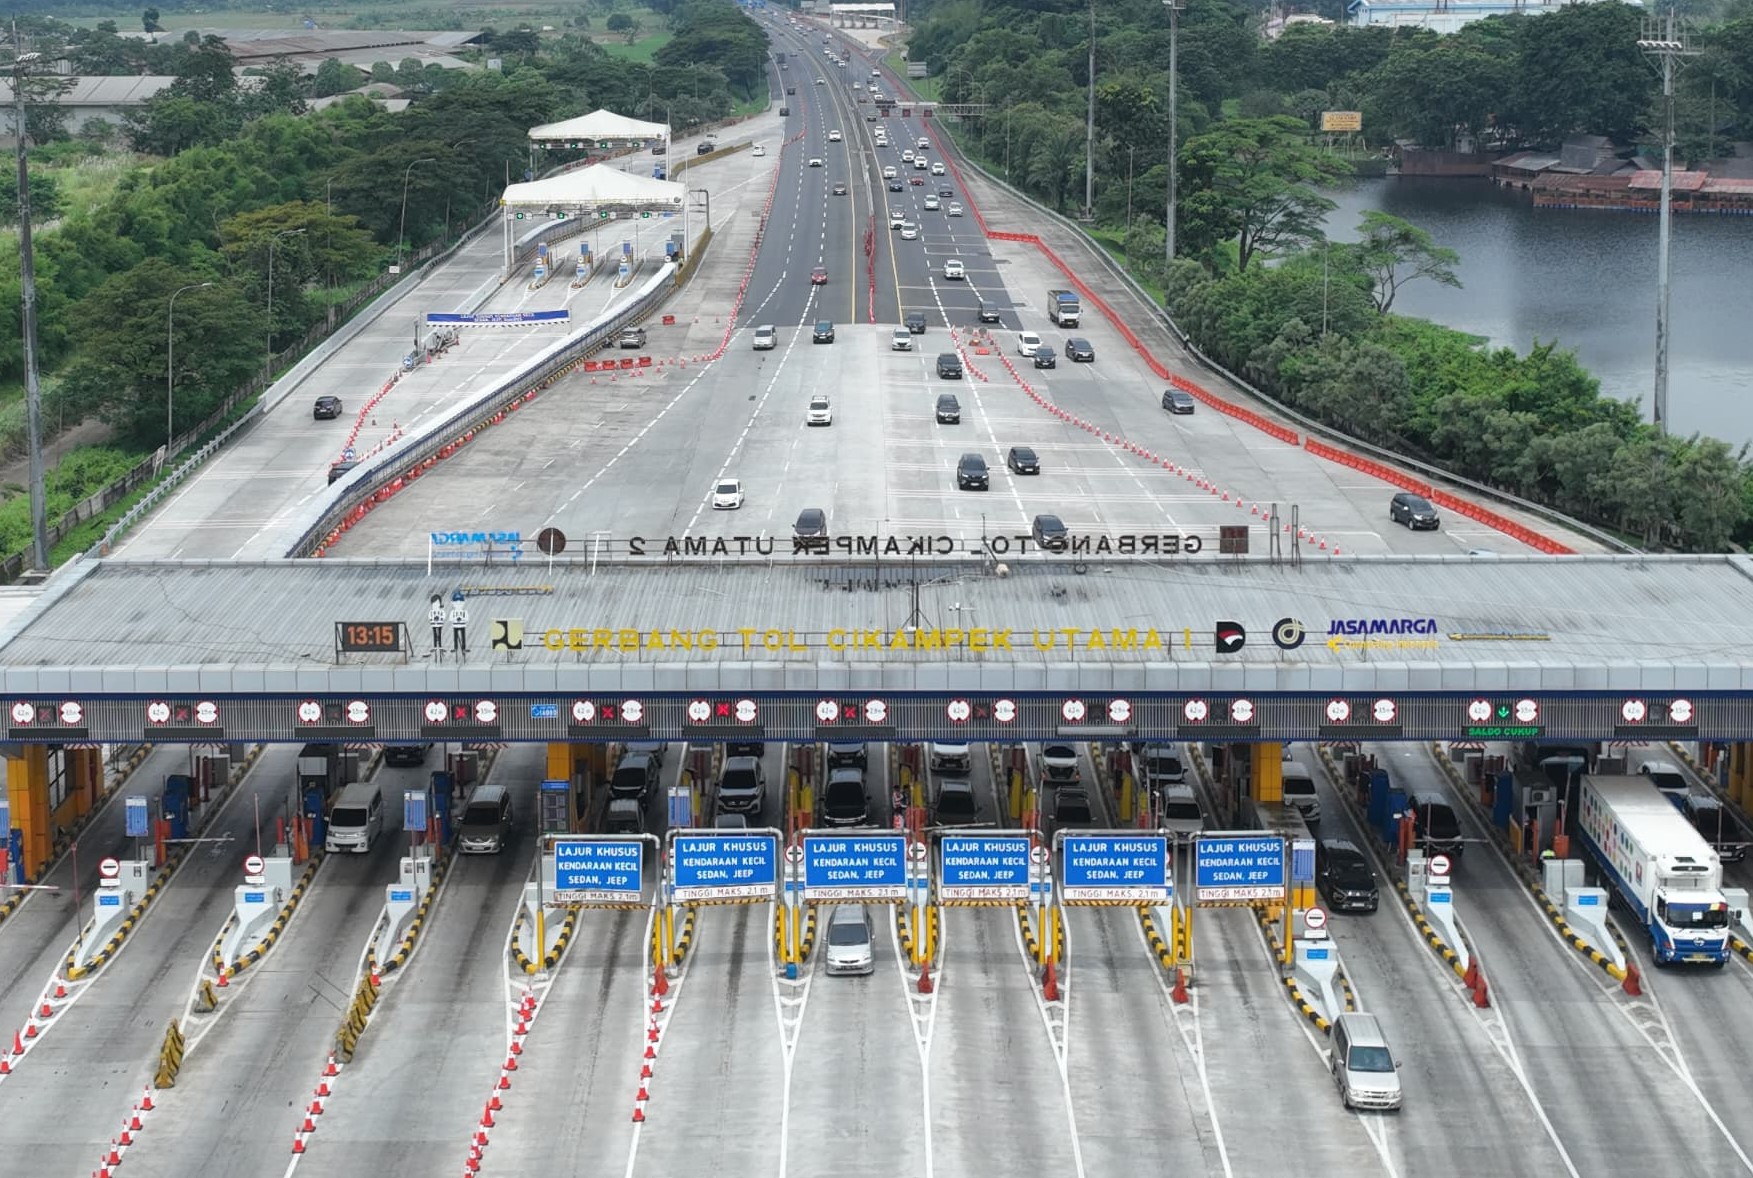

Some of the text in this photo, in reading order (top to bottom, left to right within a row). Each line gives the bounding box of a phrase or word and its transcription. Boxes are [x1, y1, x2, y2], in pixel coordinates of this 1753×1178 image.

[1326, 619, 1438, 635] JASAMARGA
[347, 625, 394, 645] 13:15
[543, 628, 718, 652] GERBANG
[736, 628, 807, 652] TOL
[827, 628, 1013, 652] CIKAMPEK
[1032, 628, 1162, 652] UTAMA
[1468, 727, 1538, 736] SALDO CUKUP
[683, 842, 767, 852] LAJUR KHUSUS
[813, 843, 898, 853] LAJUR KHUSUS
[946, 843, 1026, 852] LAJUR KHUSUS
[1073, 843, 1158, 852] LAJUR KHUSUS
[1200, 842, 1280, 854] LAJUR KHUSUS
[558, 847, 638, 857] LAJUR KHUSUS
[683, 857, 766, 867] KENDARAAN KECIL
[813, 858, 897, 867] KENDARAAN KECIL
[945, 857, 1026, 866] KENDARAAN KECIL
[1073, 858, 1157, 866] KENDARAAN KECIL
[1200, 857, 1280, 867] KENDARAAN KECIL
[558, 862, 638, 871] KENDARAAN KECIL
[733, 869, 754, 878] JEEP
[864, 870, 884, 879] JEEP
[994, 870, 1014, 880] JEEP
[1124, 870, 1144, 879] JEEP
[1248, 871, 1269, 880] JEEP
[606, 876, 628, 885] JEEP
[559, 892, 586, 900] TINGGI
[683, 890, 712, 898] TINGGI
[813, 890, 842, 898] TINGGI
[946, 888, 975, 897] TINGGI
[1073, 889, 1102, 897] TINGGI
[1201, 889, 1230, 898] TINGGI
